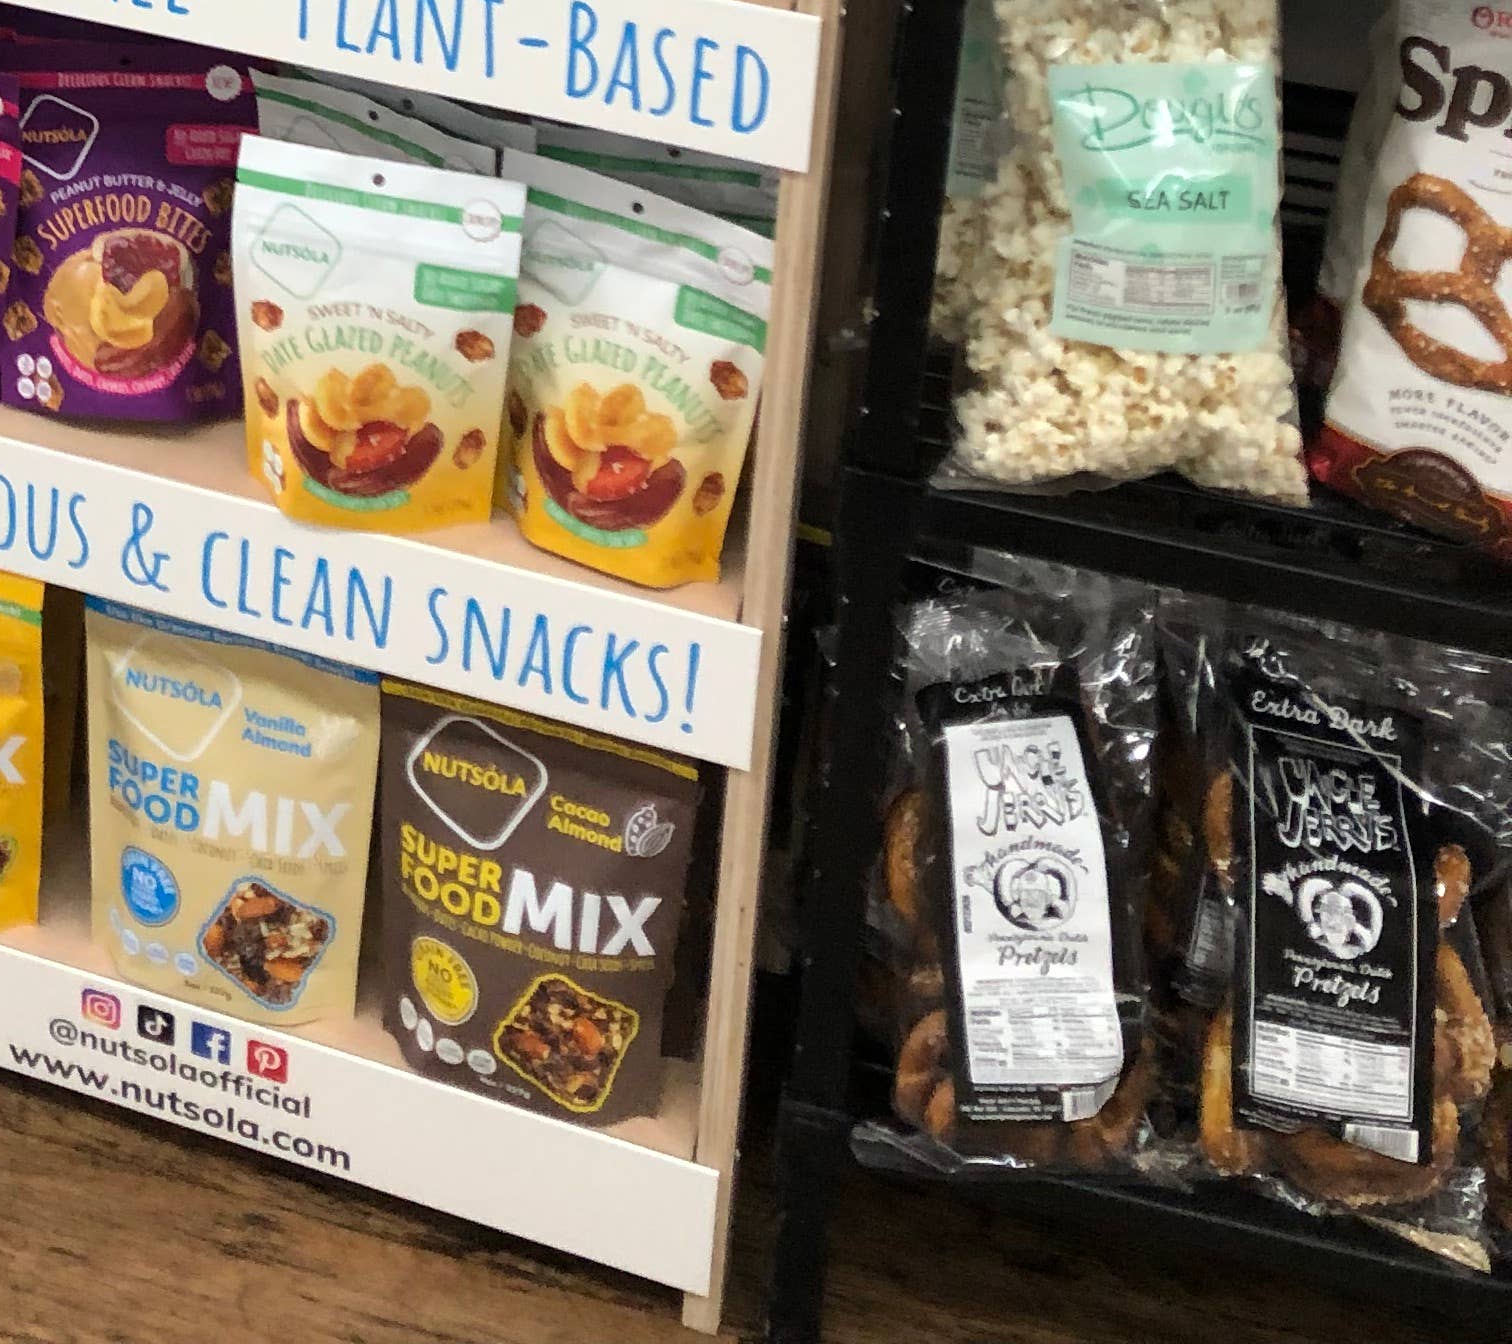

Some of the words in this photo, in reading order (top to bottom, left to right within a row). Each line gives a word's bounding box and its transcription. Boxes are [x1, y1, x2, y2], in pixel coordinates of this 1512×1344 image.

[1127, 190, 1170, 211] SEA
[1178, 190, 1230, 211] SALT
[306, 301, 367, 323] SWEET
[386, 309, 435, 340] SALTY
[261, 334, 304, 376] DATE
[306, 325, 383, 355] GLAZED
[388, 334, 476, 409] PEANUTS
[1389, 388, 1436, 410] MORE
[119, 502, 172, 592] &
[200, 530, 392, 649] CLEAN
[425, 589, 703, 736] SNACKS!
[124, 666, 223, 709] NUTSÓLA
[243, 707, 306, 737] Vanilla
[1251, 690, 1320, 726] Extra
[1330, 706, 1397, 741] Dark
[241, 727, 314, 758] Almond
[107, 739, 200, 801] SUPER
[422, 750, 528, 799] NUTSÓLA
[107, 770, 200, 833] FOOD
[201, 779, 355, 859] MIX
[550, 794, 611, 828] Cacao
[401, 823, 503, 892] SUPER
[547, 814, 623, 855] Almond
[401, 851, 501, 926] FOOD
[502, 868, 663, 957] MIX
[998, 946, 1078, 976] Pretzels
[1293, 965, 1380, 1008] Pretzels
[48, 1017, 312, 1119] @nutsolaofficial
[8, 1043, 352, 1171] www.nutsola.com
